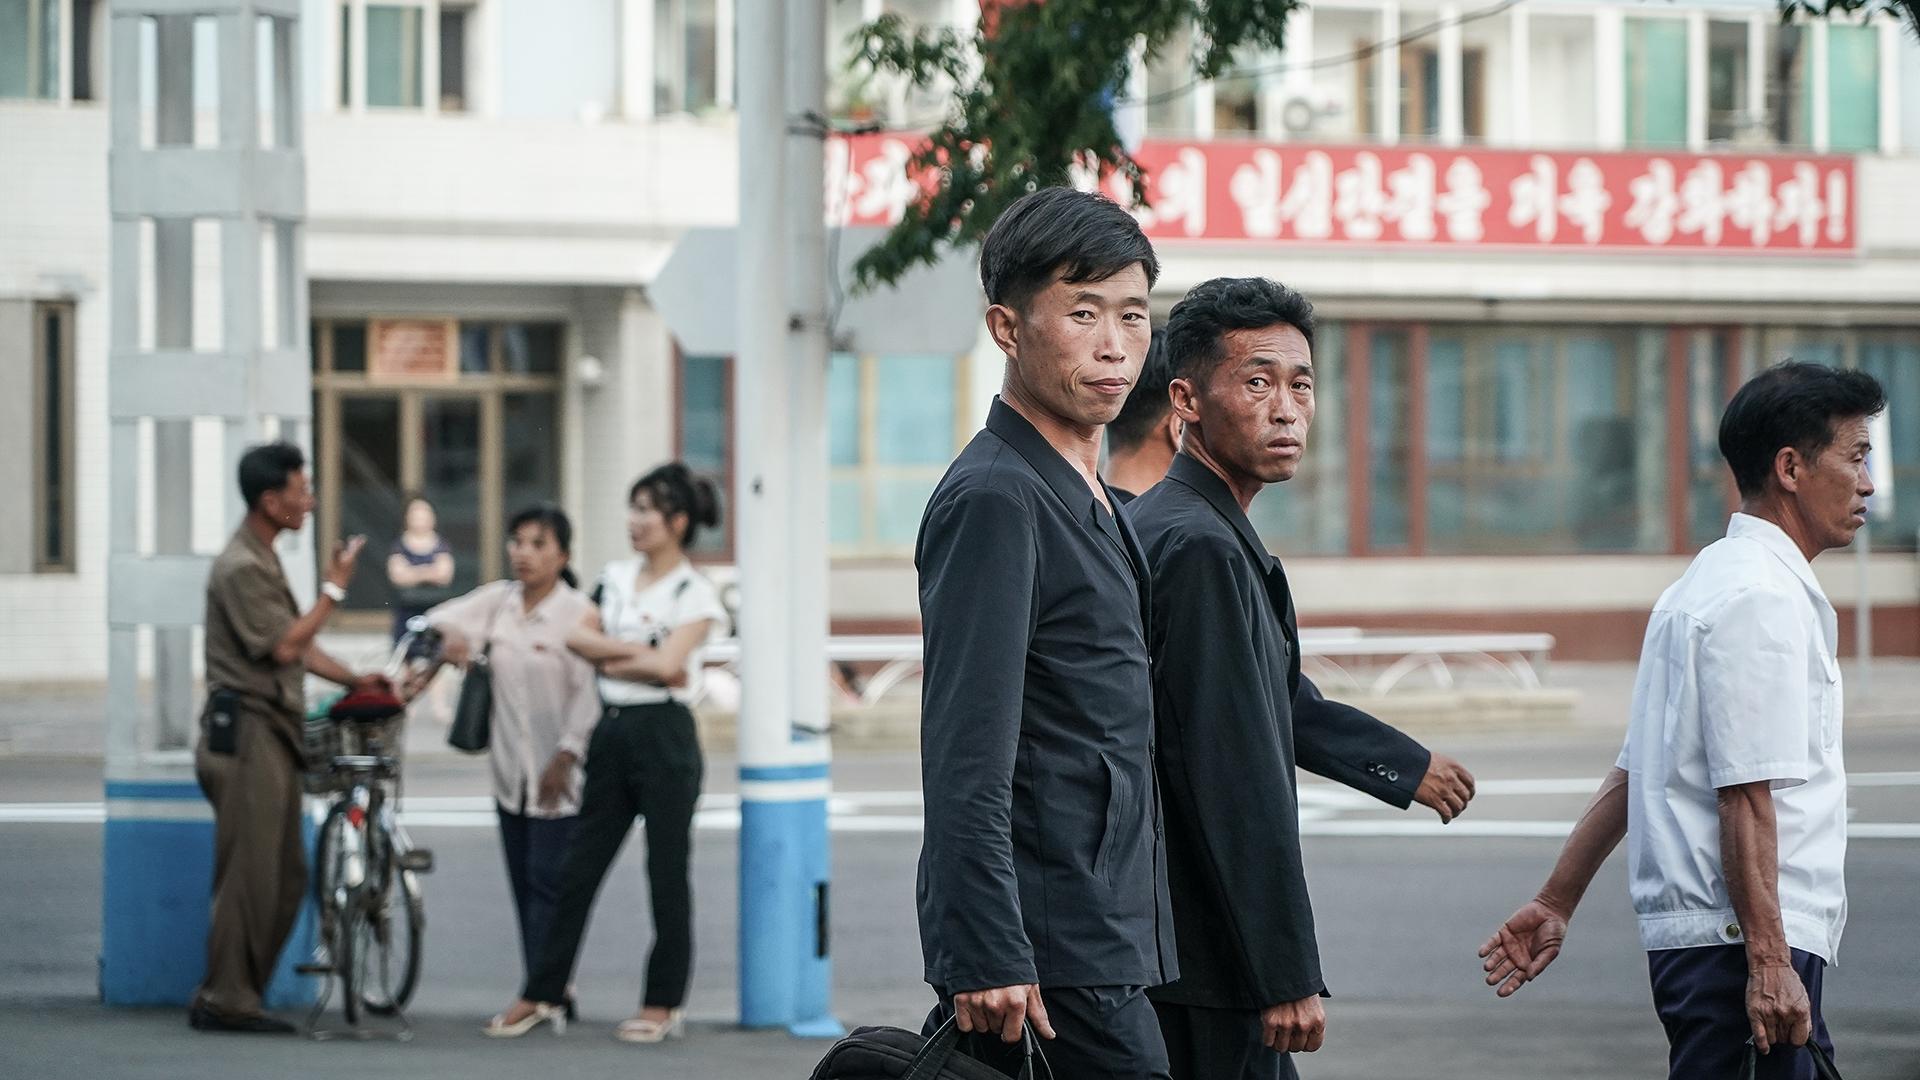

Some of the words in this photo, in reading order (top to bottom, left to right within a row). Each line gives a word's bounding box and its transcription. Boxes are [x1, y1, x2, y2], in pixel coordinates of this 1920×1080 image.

[1229, 148, 1492, 240] 일심단결을
[1508, 153, 1612, 242] 더욱
[1623, 156, 1847, 245] 강화하자!
